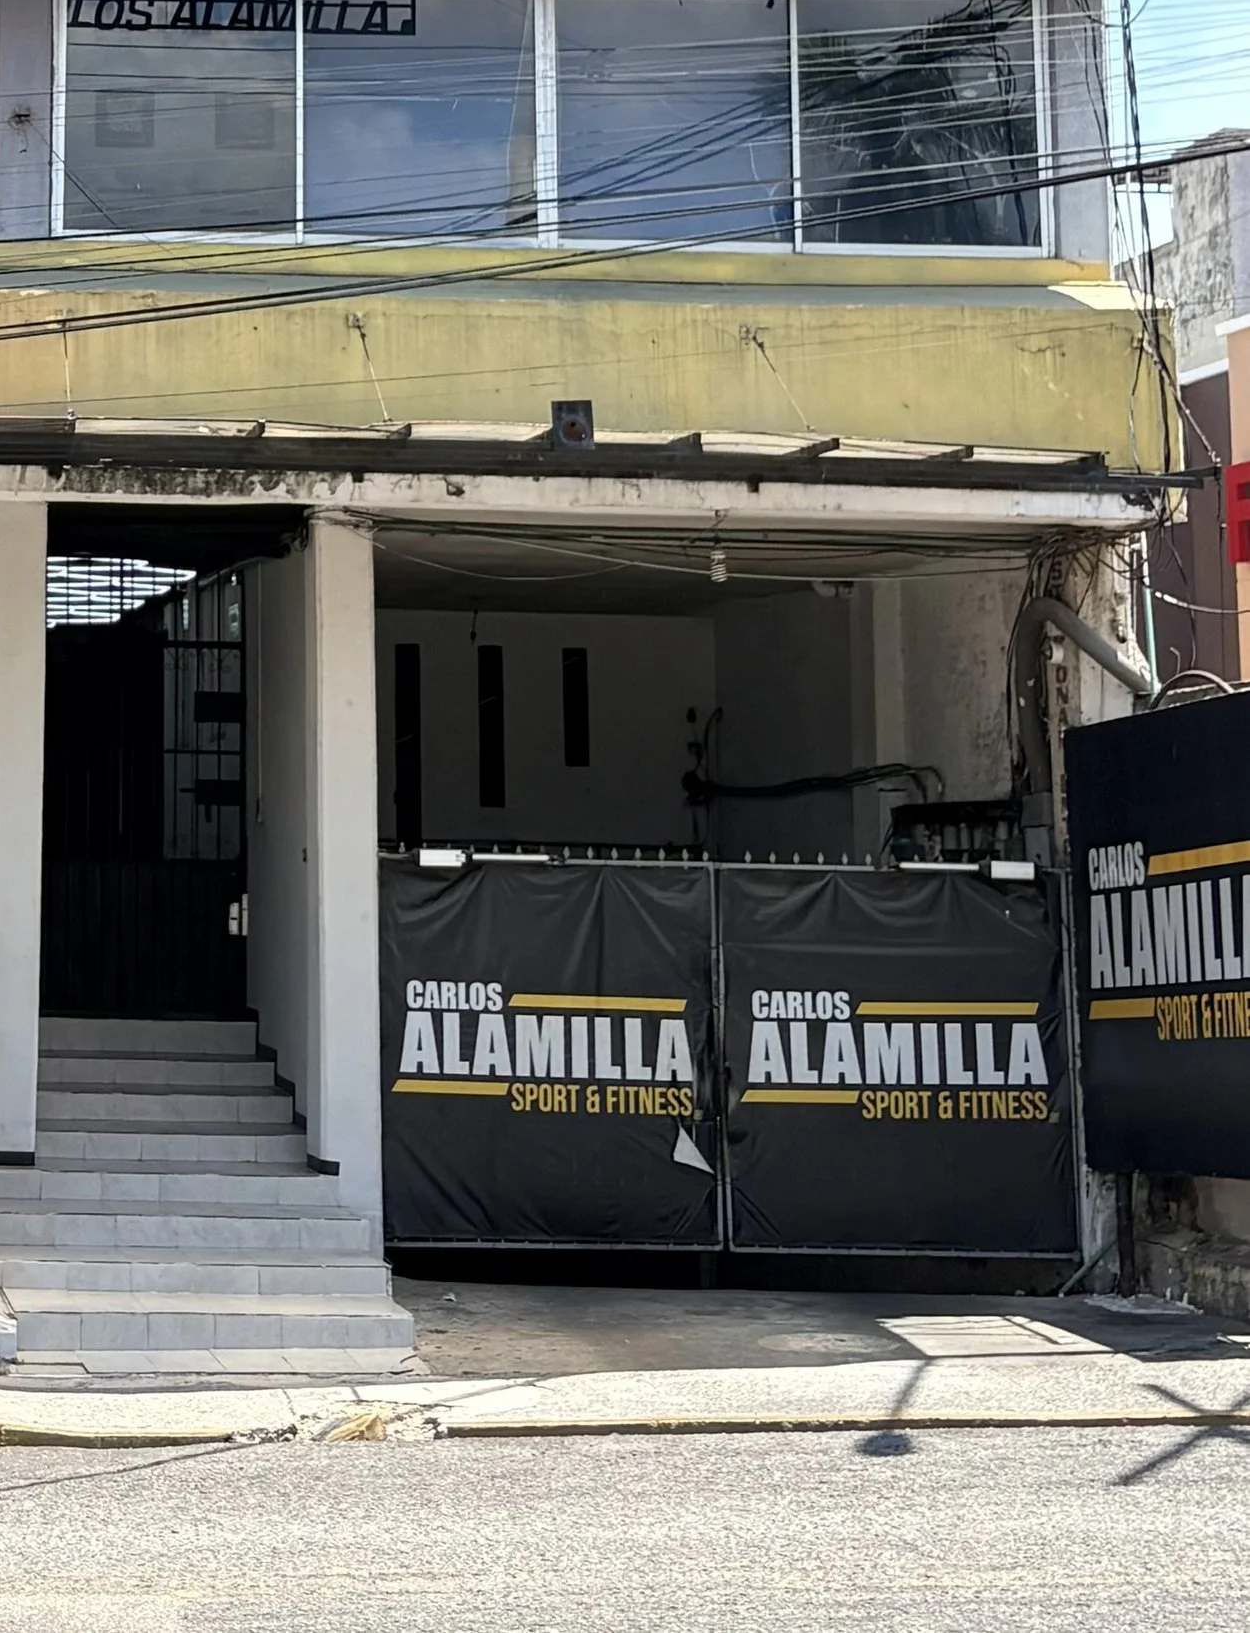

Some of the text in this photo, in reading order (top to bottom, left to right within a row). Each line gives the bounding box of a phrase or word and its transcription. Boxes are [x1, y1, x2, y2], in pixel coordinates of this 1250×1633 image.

[1088, 841, 1146, 891] CARLOS
[405, 979, 504, 1012] CARLOS
[750, 989, 851, 1021] CARLOS
[1156, 994, 1198, 1041] SPORT
[1201, 993, 1212, 1039] &
[399, 1011, 695, 1082] ALAMILLA
[747, 1021, 1049, 1086] ALAMILLA
[510, 1082, 693, 1117] SPORT & FITNESS
[861, 1090, 1049, 1121] SPORT & FITNESS
